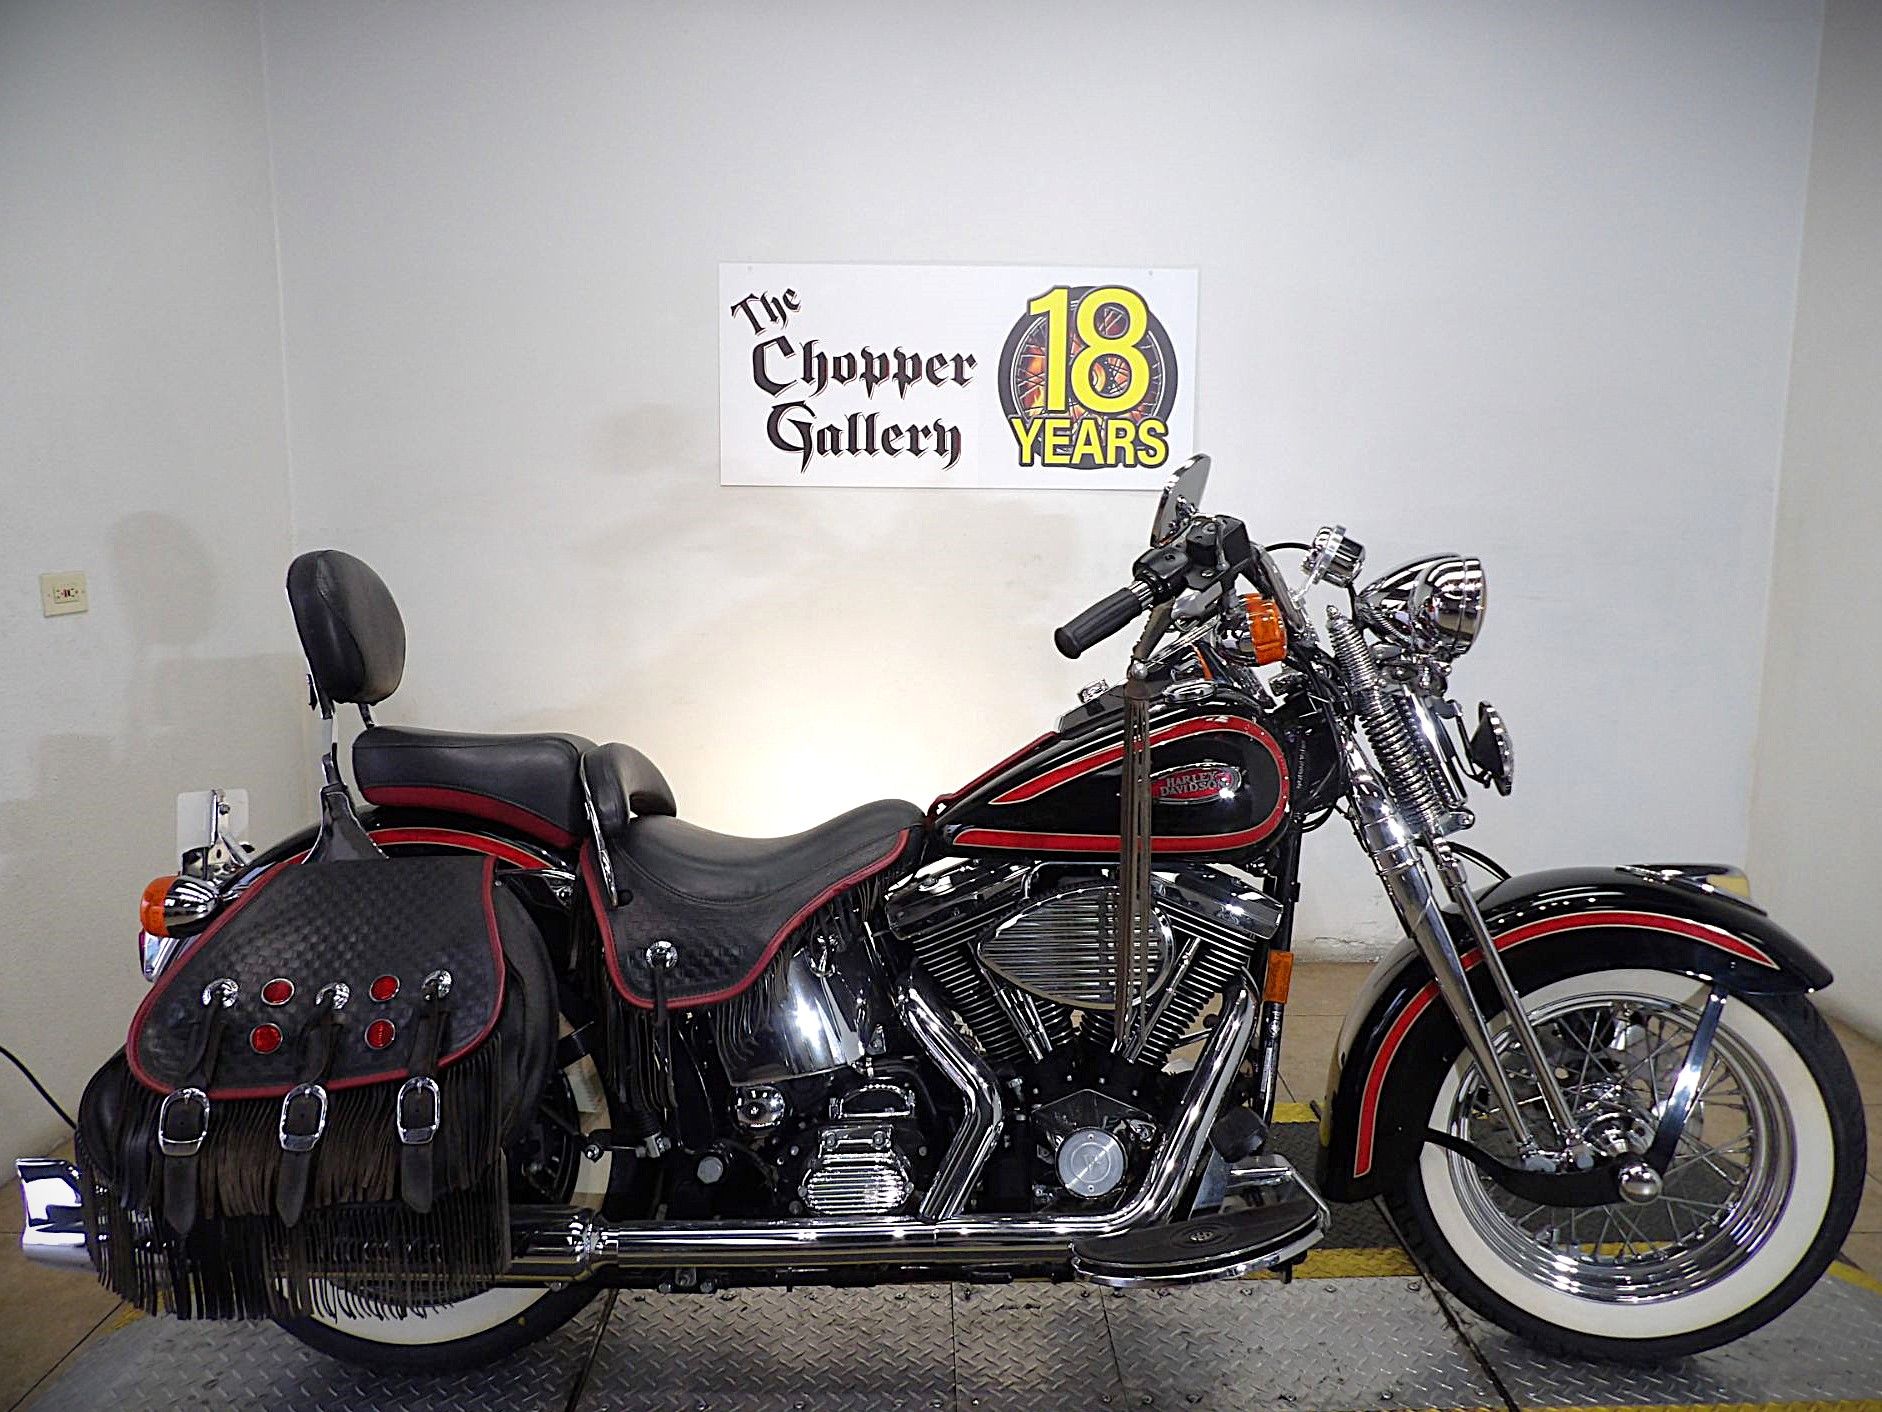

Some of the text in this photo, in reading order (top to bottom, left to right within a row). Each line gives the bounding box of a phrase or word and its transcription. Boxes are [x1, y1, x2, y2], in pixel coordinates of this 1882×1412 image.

[730, 288, 801, 336] The
[752, 335, 977, 400] Chopper
[1028, 286, 1151, 413] 18
[766, 400, 962, 473] Gallery
[1010, 417, 1168, 467] YEARS
[1167, 771, 1218, 787] HARLEY
